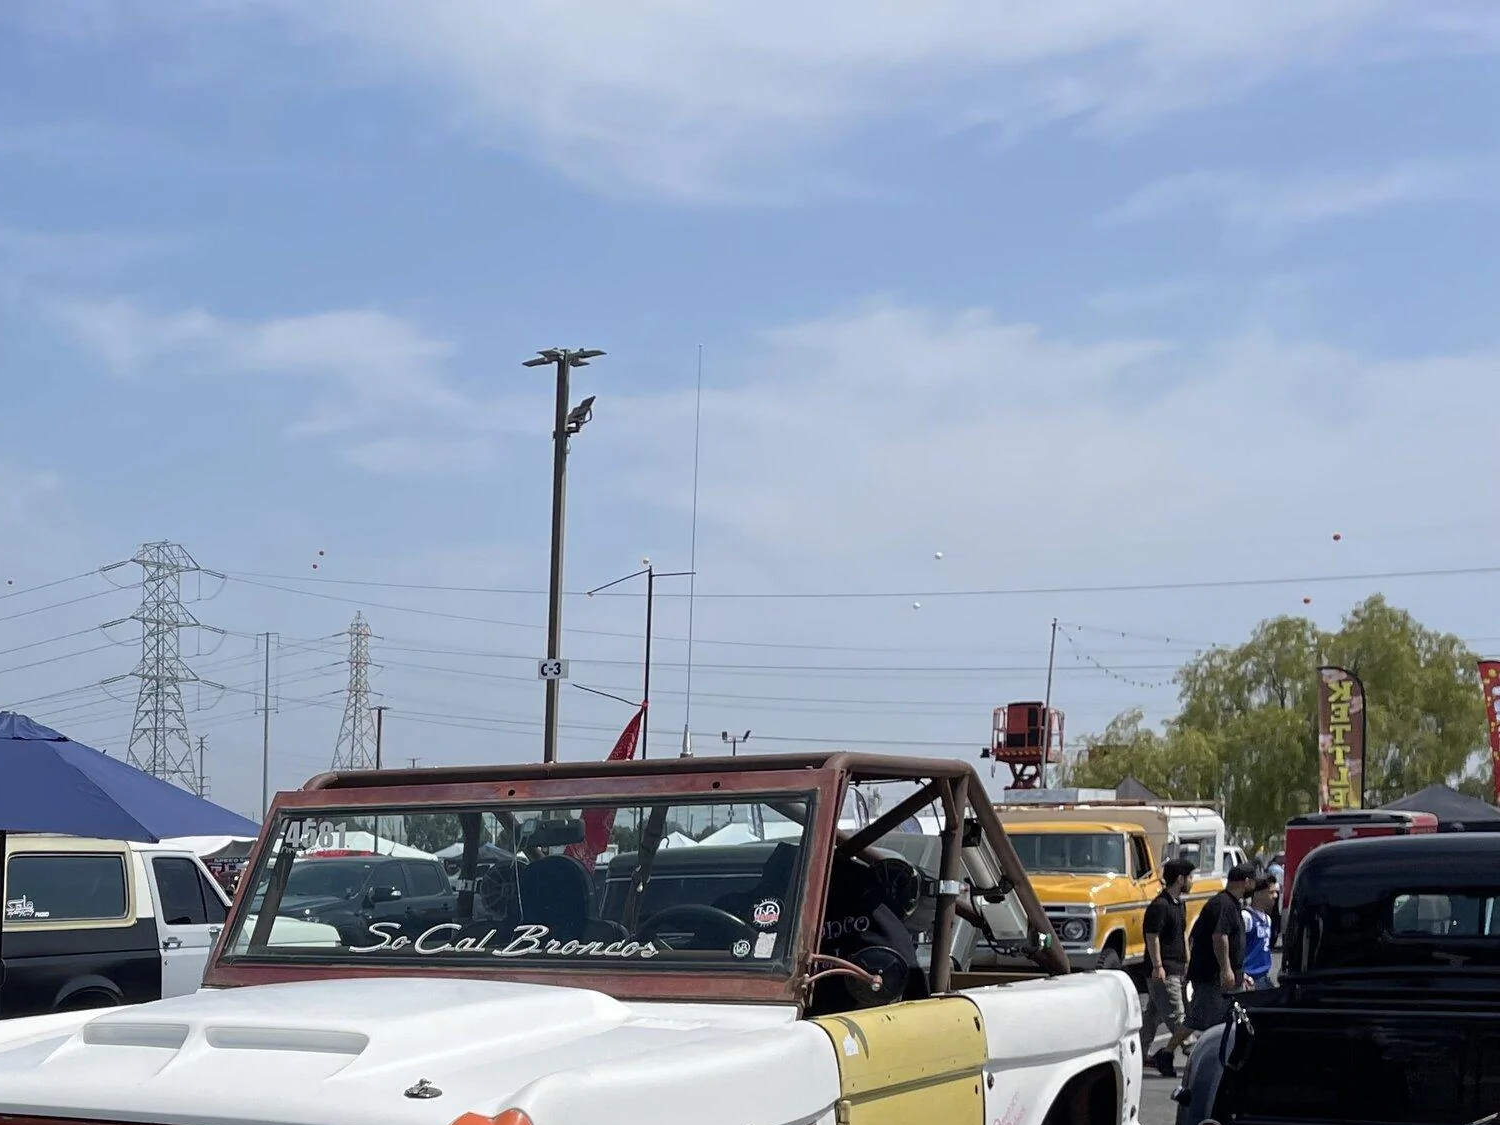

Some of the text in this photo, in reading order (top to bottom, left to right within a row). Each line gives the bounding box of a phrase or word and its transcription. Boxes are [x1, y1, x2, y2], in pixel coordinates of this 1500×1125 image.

[540, 662, 562, 676] C-3
[285, 818, 347, 849] 4581
[492, 924, 660, 957] Broncos
